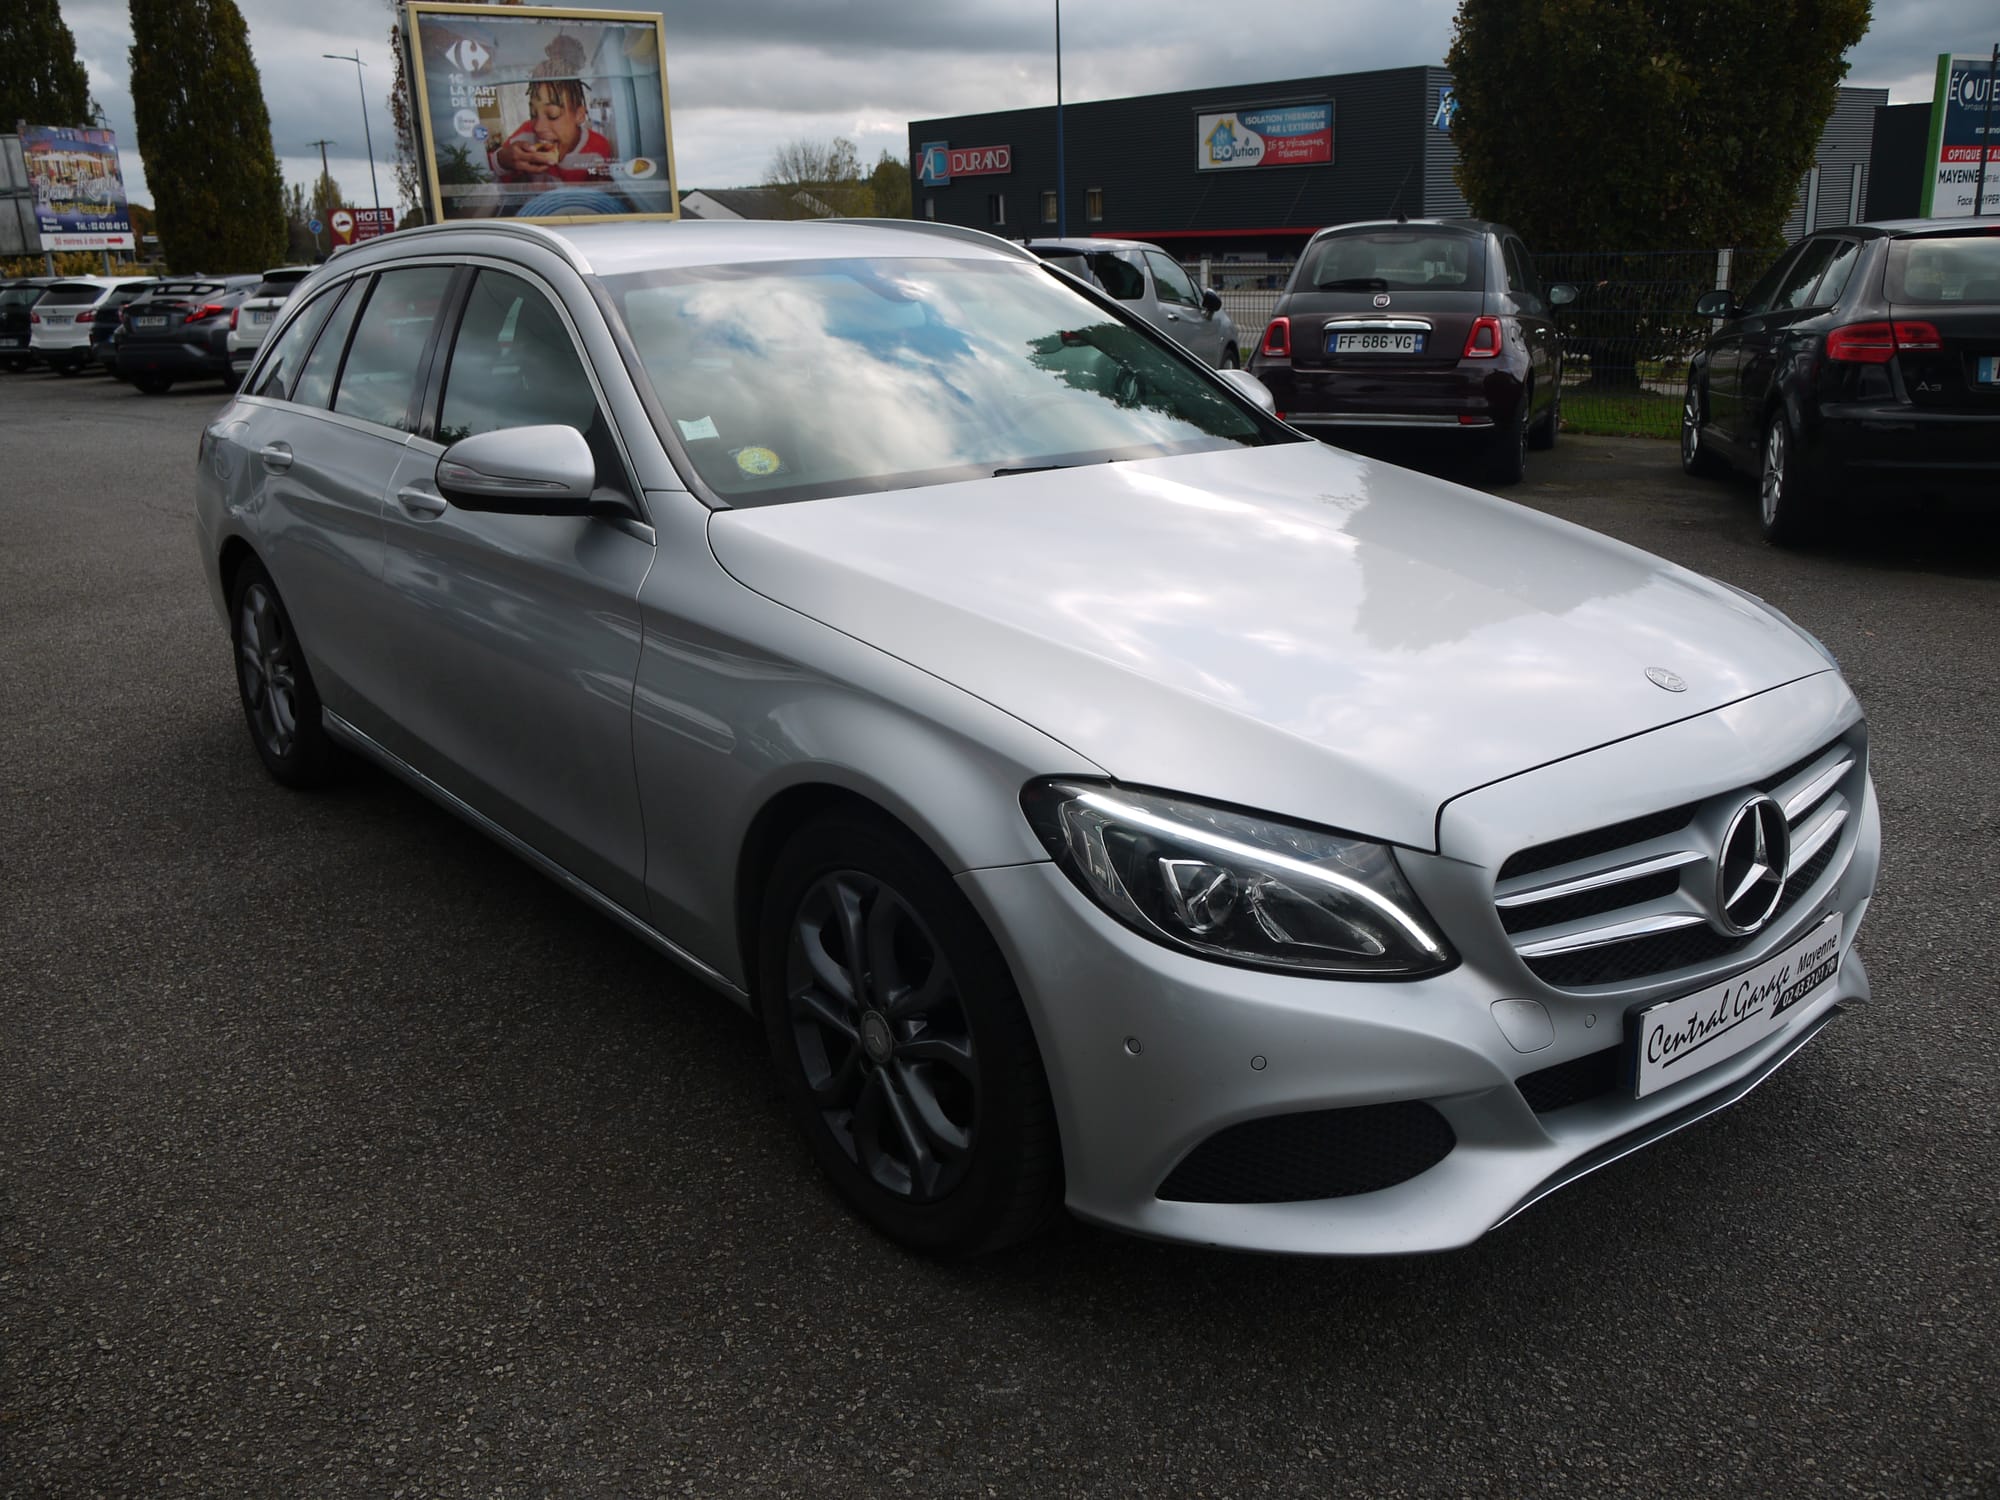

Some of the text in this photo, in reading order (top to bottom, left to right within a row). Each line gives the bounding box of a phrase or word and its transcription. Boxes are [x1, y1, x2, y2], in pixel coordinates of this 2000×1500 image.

[450, 86, 497, 96] LA PART
[451, 97, 497, 108] DE KIFF
[1245, 110, 1326, 125] ISOLATION THERMIQUE
[1267, 123, 1281, 133] PAR
[952, 150, 1009, 172] DURAND
[1948, 149, 1981, 161] OPTIQUE
[1938, 169, 1981, 184] MAYENNE
[355, 210, 392, 222] HOTEL
[1338, 335, 1412, 349] FF-686-VG
[1797, 934, 1838, 975] Mayenne
[1647, 965, 1790, 1064] Central Garage
